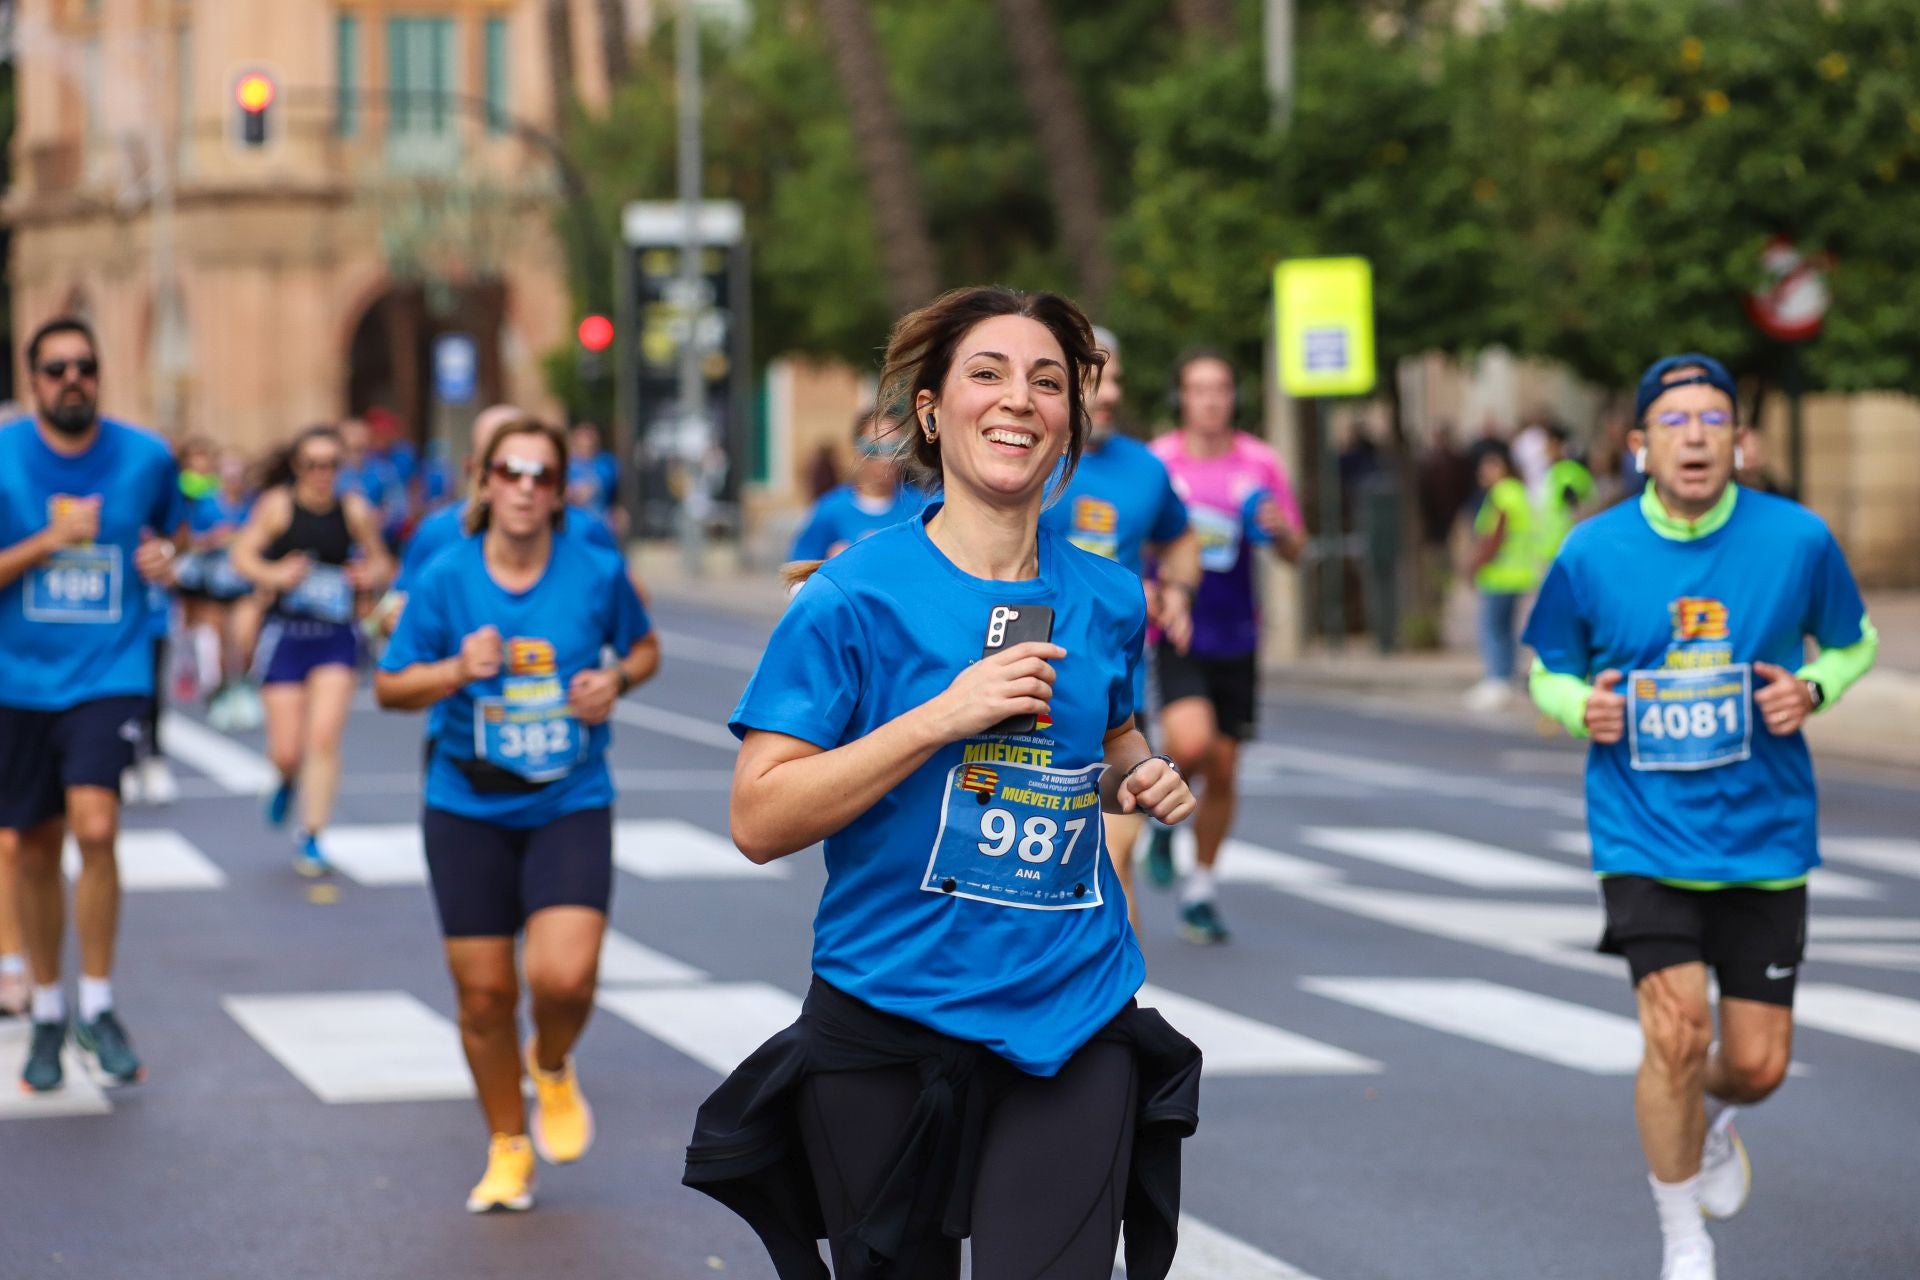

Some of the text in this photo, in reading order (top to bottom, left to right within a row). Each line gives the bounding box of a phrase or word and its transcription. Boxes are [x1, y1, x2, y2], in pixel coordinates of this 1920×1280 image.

[1639, 698, 1738, 740] 4081
[963, 739, 1053, 768] MUÉVETE
[1041, 774, 1050, 782] 24
[1001, 786, 1062, 811] MUÉVETE
[1062, 796, 1072, 811] X
[977, 808, 1087, 865] 987
[1015, 868, 1041, 880] ANA
